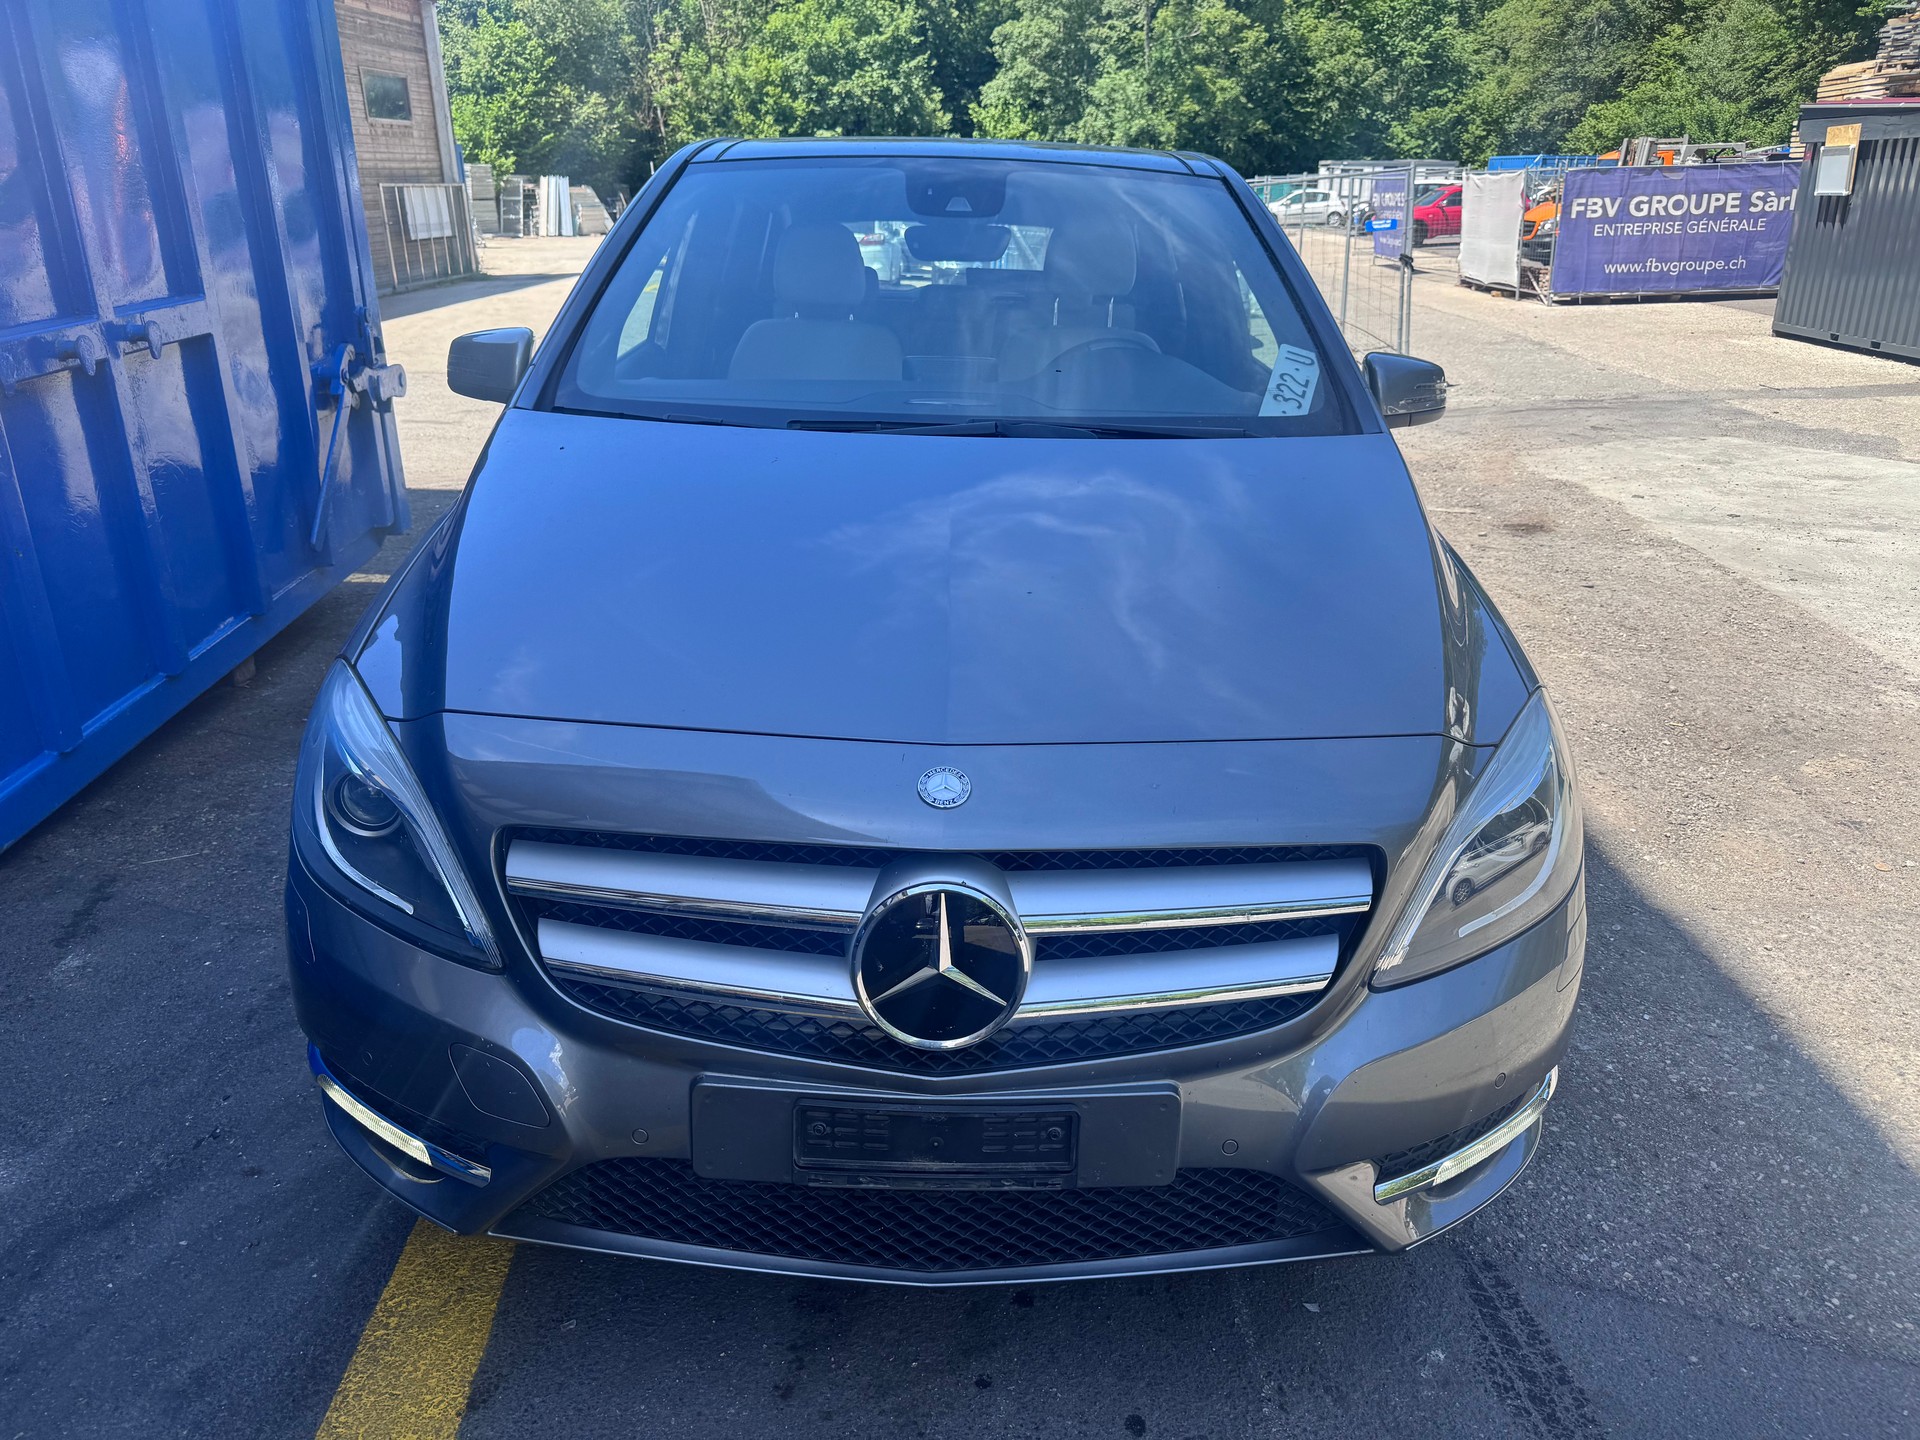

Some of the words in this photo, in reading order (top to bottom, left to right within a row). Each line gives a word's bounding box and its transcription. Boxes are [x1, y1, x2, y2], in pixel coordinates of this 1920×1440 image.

[1570, 197, 1622, 219] FBV
[1629, 192, 1742, 217] GROUPE
[1748, 188, 1798, 213] Sàrl
[1594, 221, 1683, 237] ENTREPRISE
[1686, 217, 1766, 233] GÉNÉRALE
[1604, 255, 1746, 275] www.fbvgroupe.ch
